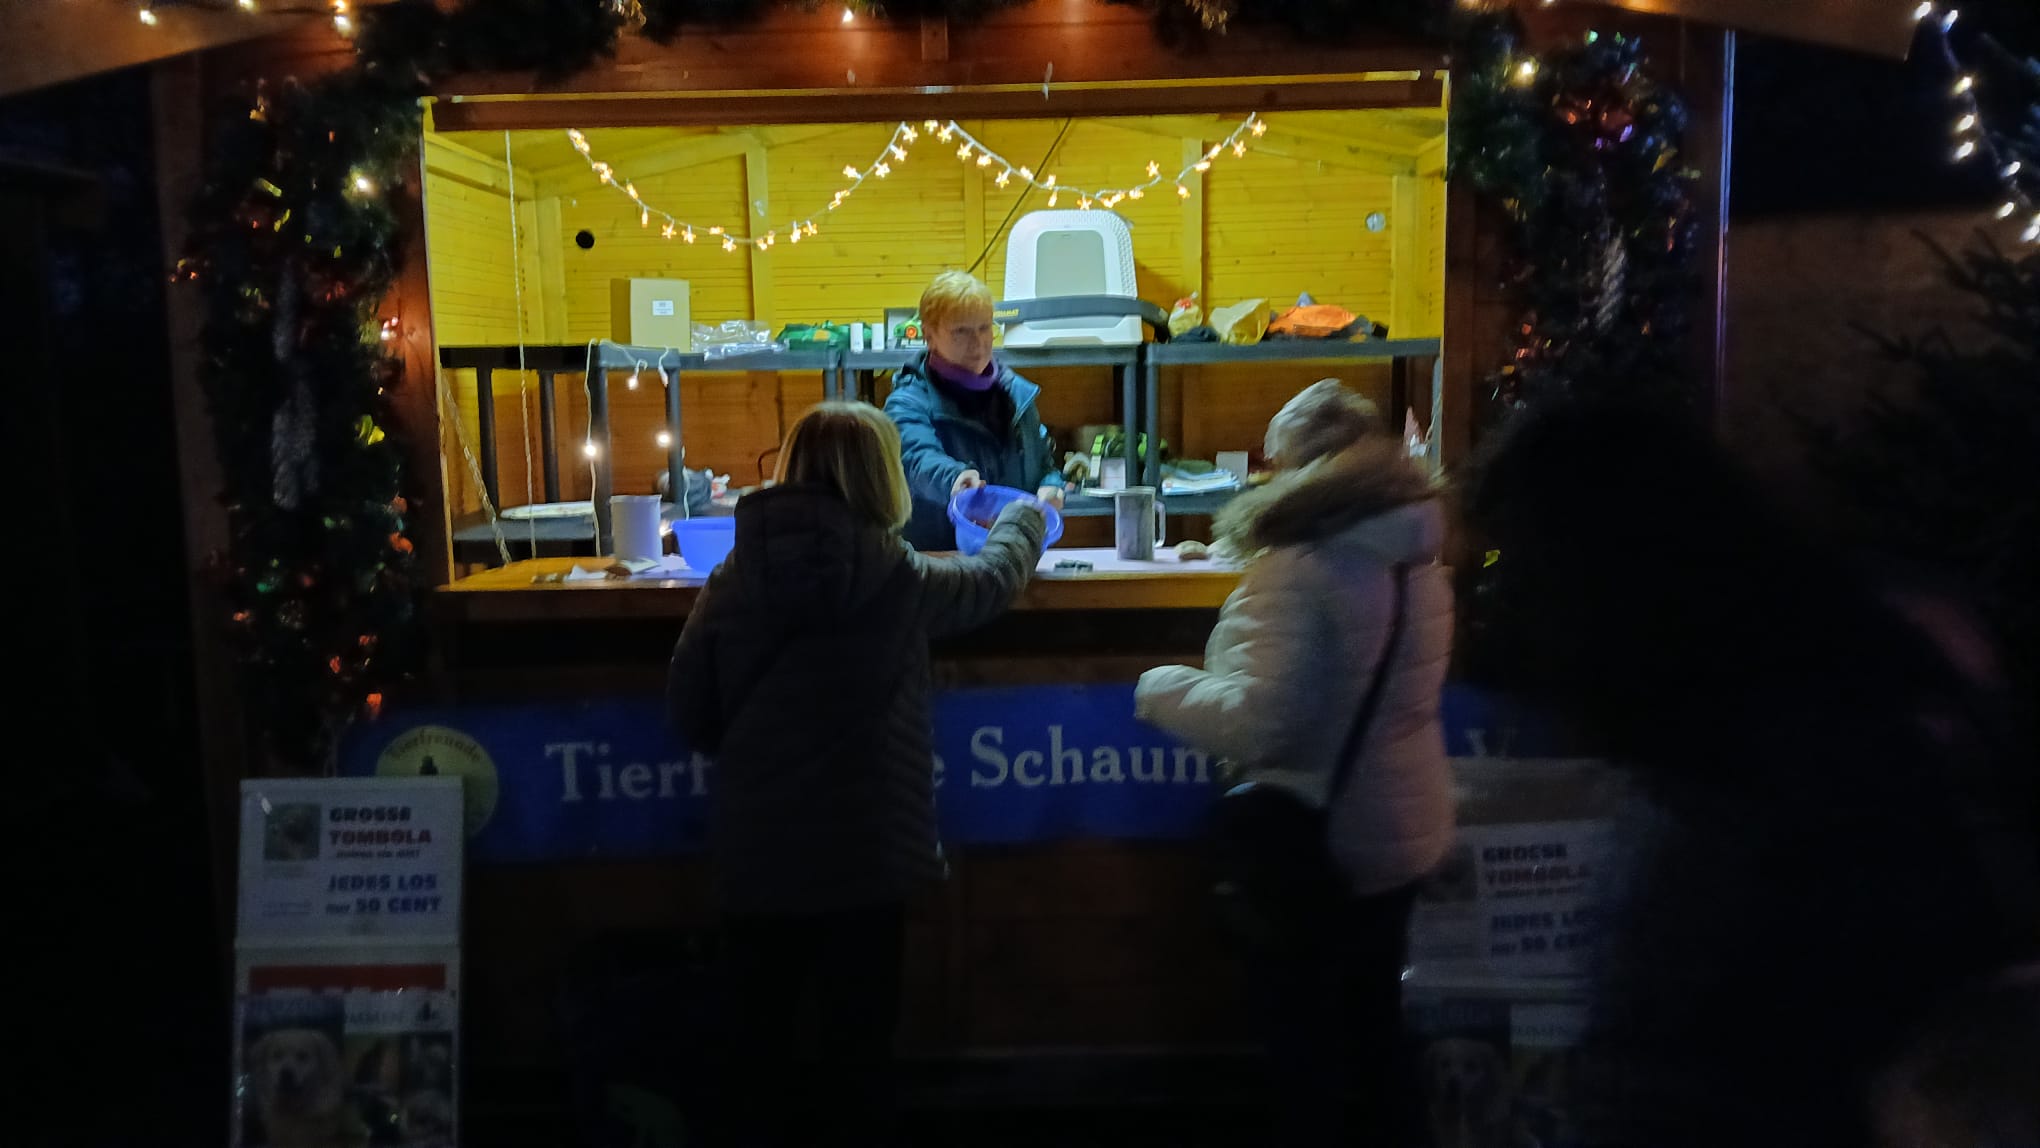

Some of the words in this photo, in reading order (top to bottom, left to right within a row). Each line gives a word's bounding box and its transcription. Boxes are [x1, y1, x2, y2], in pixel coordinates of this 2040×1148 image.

[330, 805, 411, 822] GROSSE
[329, 828, 432, 845] TOMBOLA
[327, 874, 391, 893] JEDES
[397, 872, 437, 891] LOS
[356, 897, 380, 913] 50
[387, 896, 442, 913] CENT
